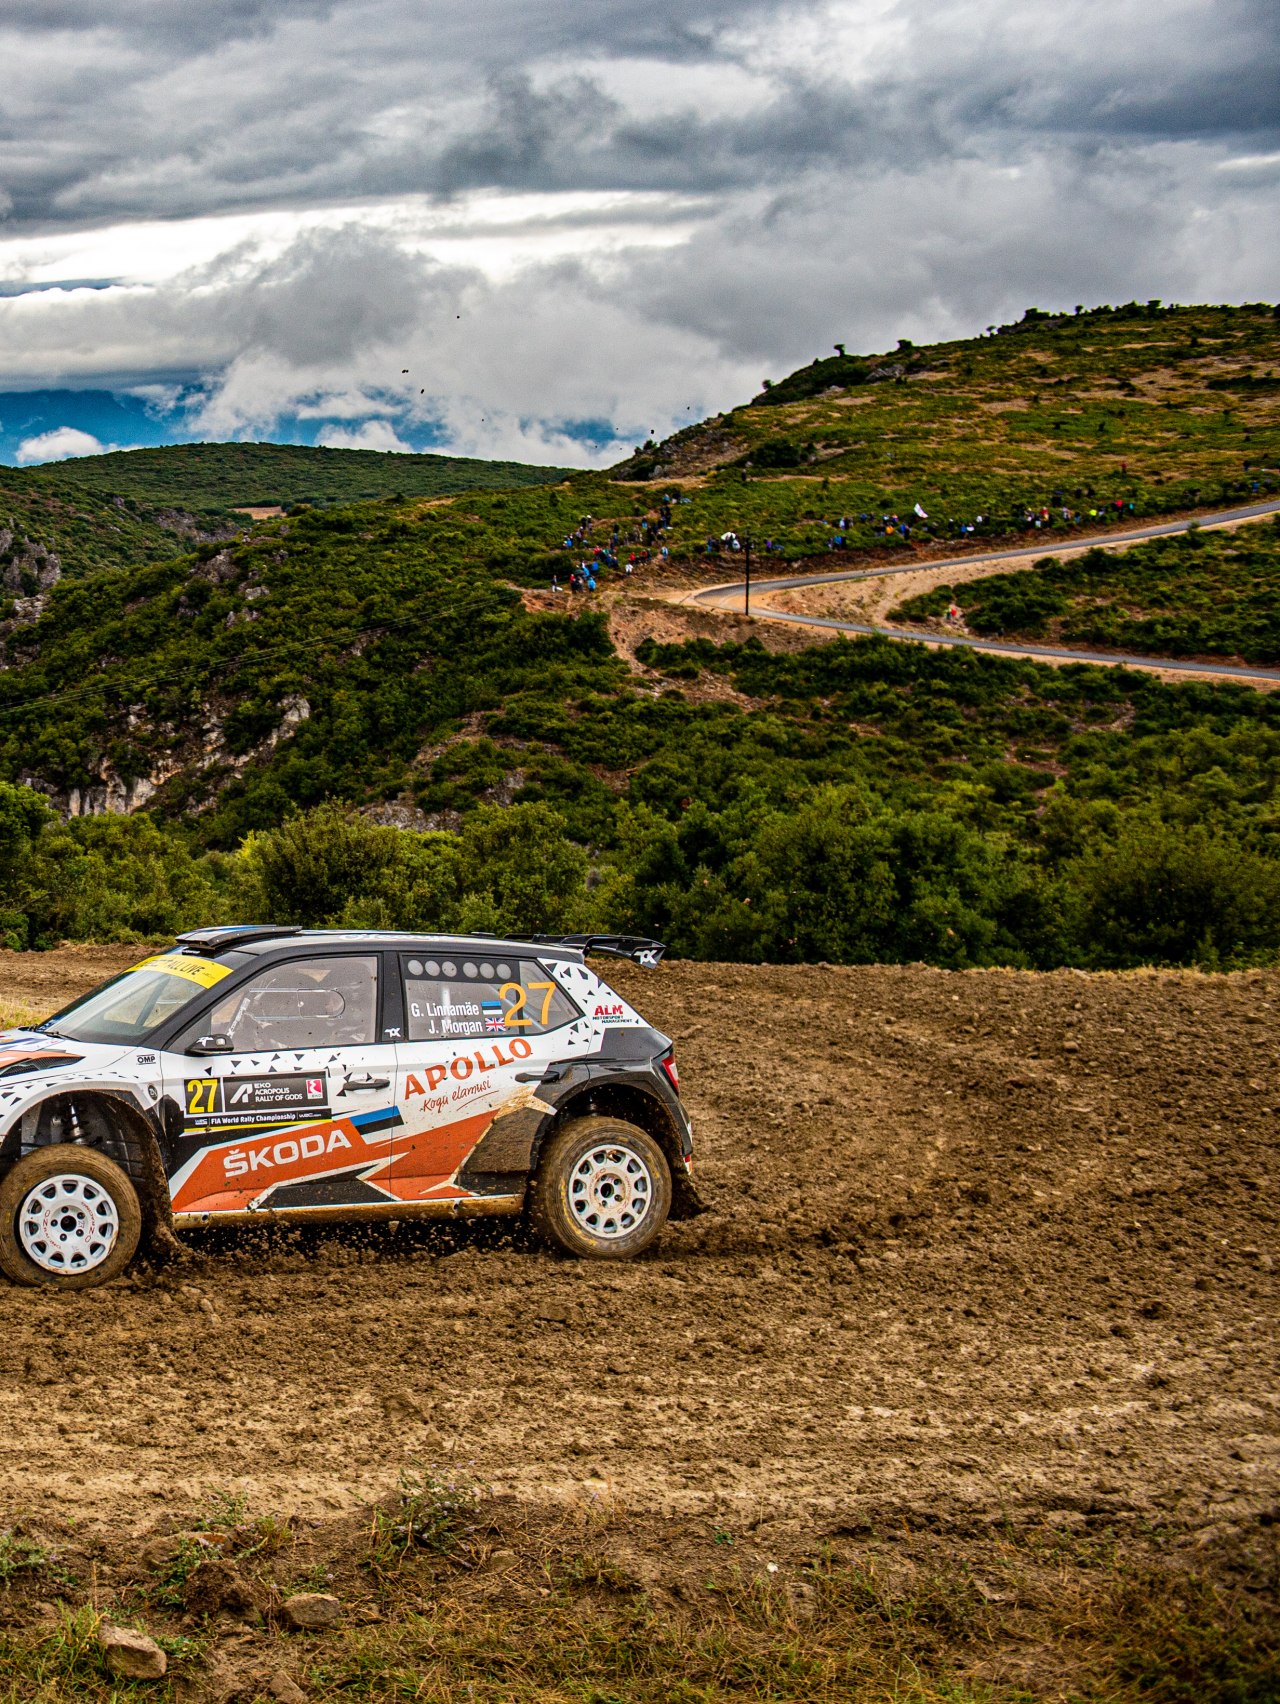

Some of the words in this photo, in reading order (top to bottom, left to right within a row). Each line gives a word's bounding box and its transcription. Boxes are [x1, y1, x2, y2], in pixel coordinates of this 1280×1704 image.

[180, 963, 206, 976] LIVE
[410, 1002, 424, 1017] G.
[426, 1001, 480, 1017] Linnamäe
[498, 981, 557, 1027] 27
[594, 1004, 624, 1016] ALM
[428, 1019, 440, 1034] J.
[441, 1019, 484, 1036] Morgan
[137, 1055, 156, 1064] OMP
[404, 1038, 532, 1101] APOLLO
[187, 1078, 218, 1114] 27
[254, 1087, 290, 1096] ACROPOLIS
[255, 1095, 274, 1103] RALLY
[423, 1096, 449, 1114] Kogu
[451, 1079, 492, 1102] elamusi
[256, 1112, 296, 1122] Championship
[223, 1129, 353, 1178] ŠKODA
